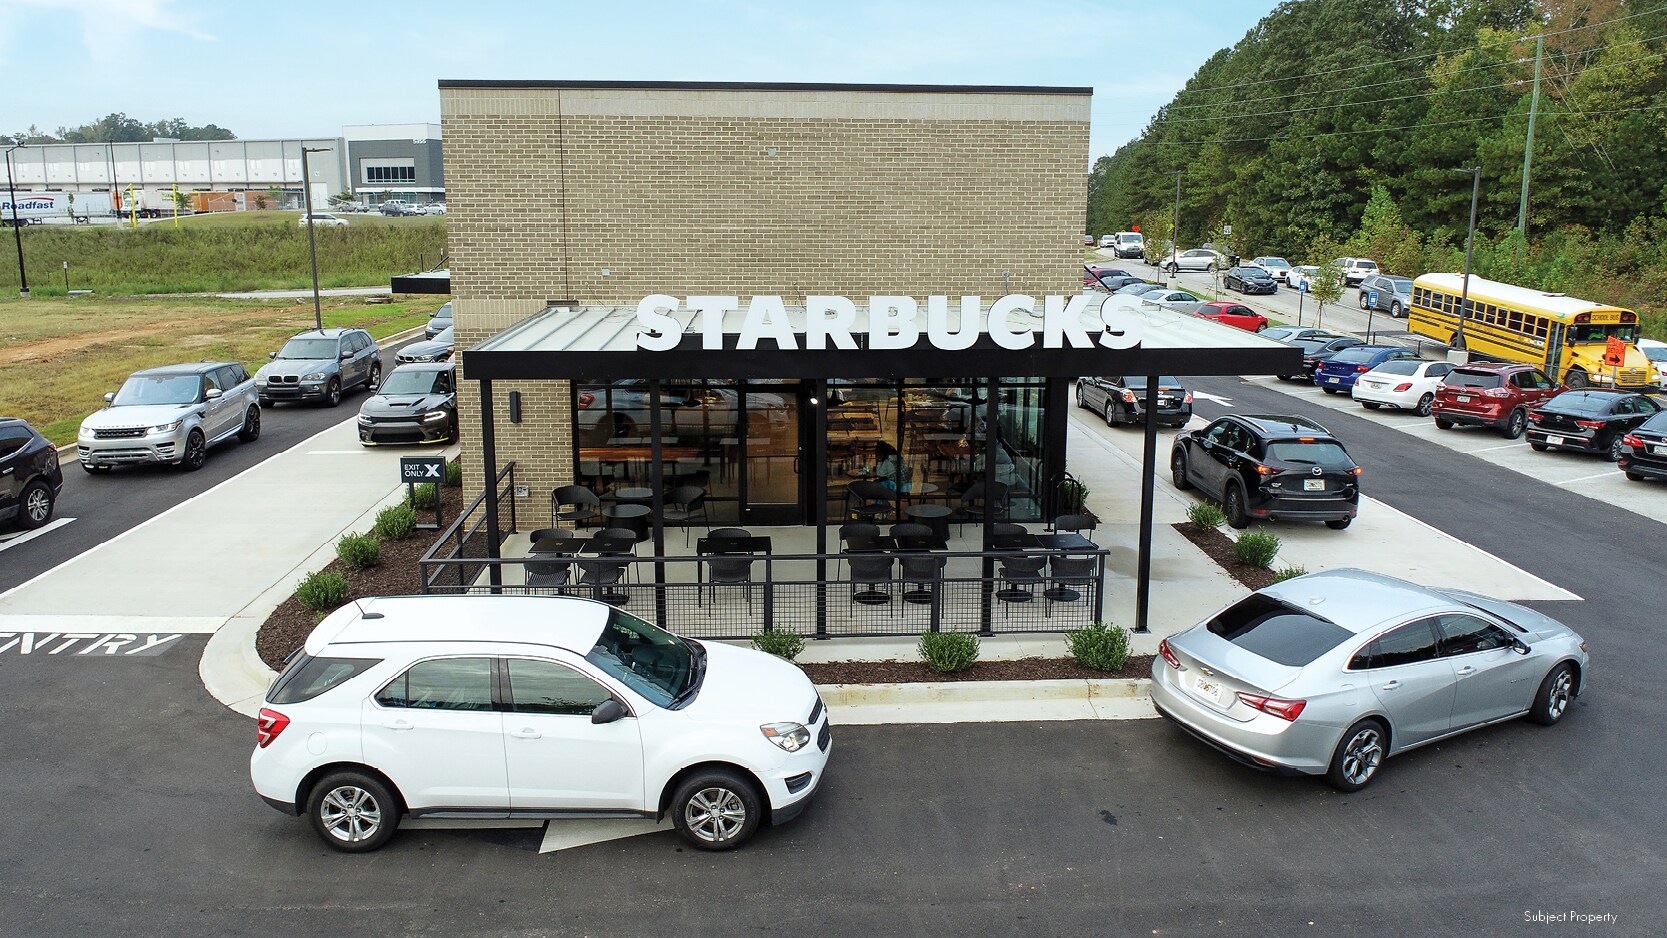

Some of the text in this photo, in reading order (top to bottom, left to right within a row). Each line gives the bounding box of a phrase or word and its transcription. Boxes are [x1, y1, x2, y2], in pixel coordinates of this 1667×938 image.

[2, 201, 54, 209] Roadfast
[637, 294, 1142, 351] STARBUCKS
[0, 633, 183, 655] NTRY
